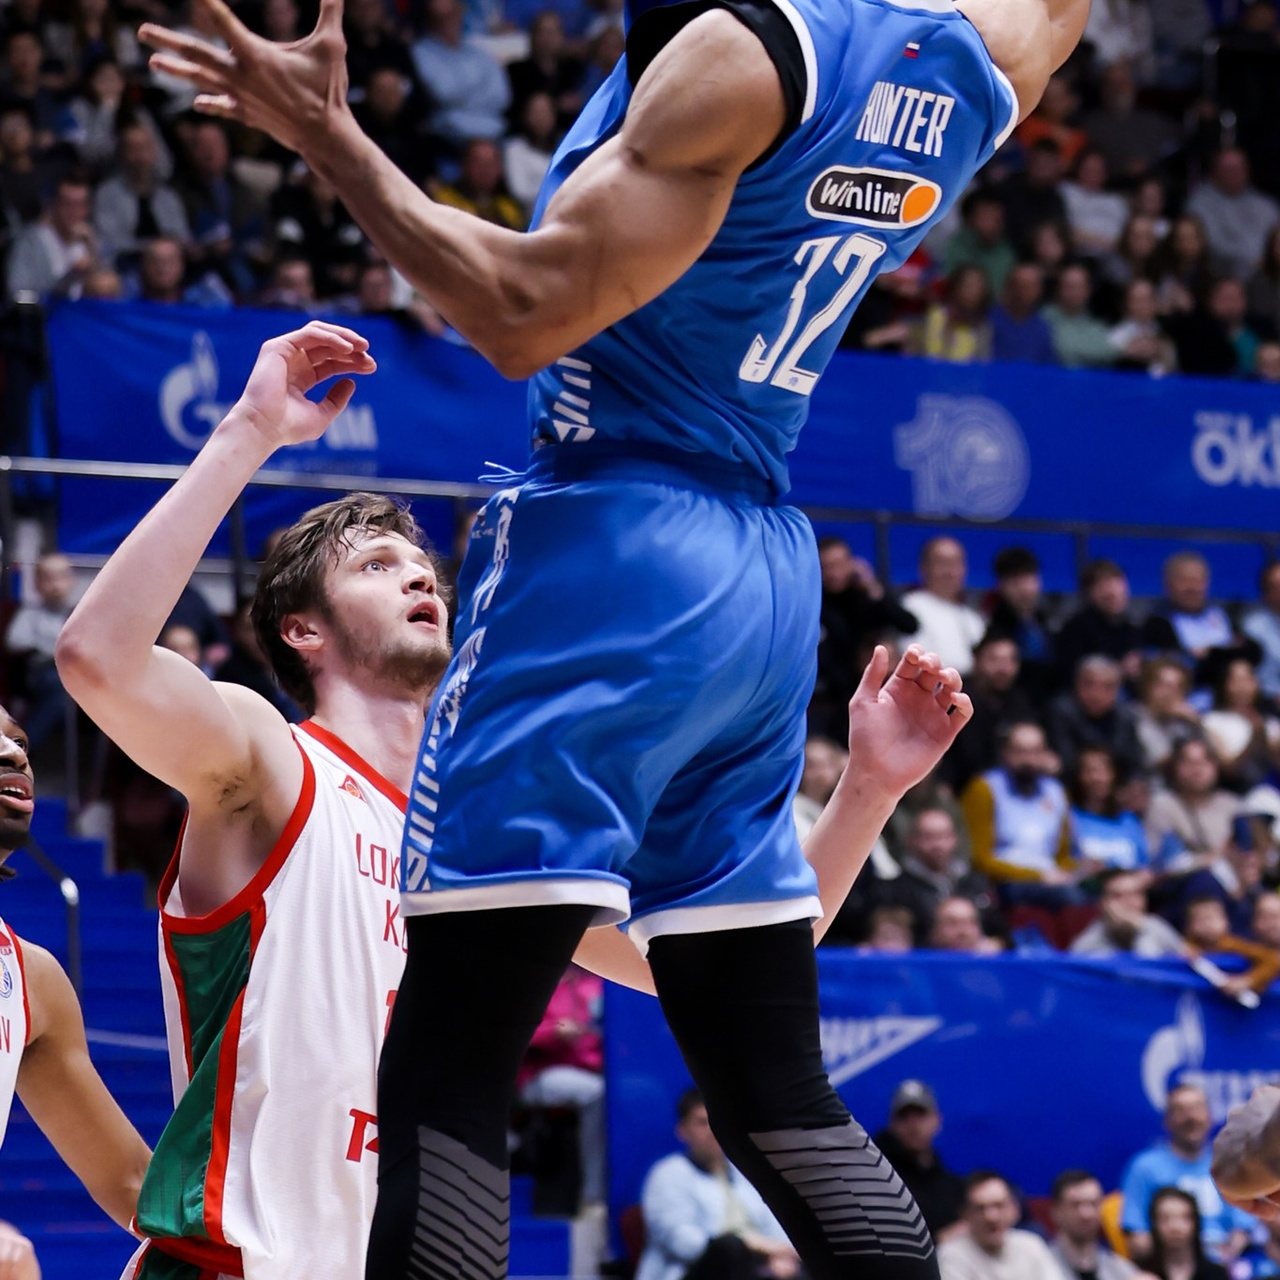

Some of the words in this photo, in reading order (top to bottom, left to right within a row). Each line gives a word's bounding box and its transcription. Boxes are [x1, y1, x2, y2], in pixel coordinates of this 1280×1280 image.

[855, 81, 955, 157] HUNTER
[820, 177, 901, 216] Winline
[739, 233, 888, 396] 32
